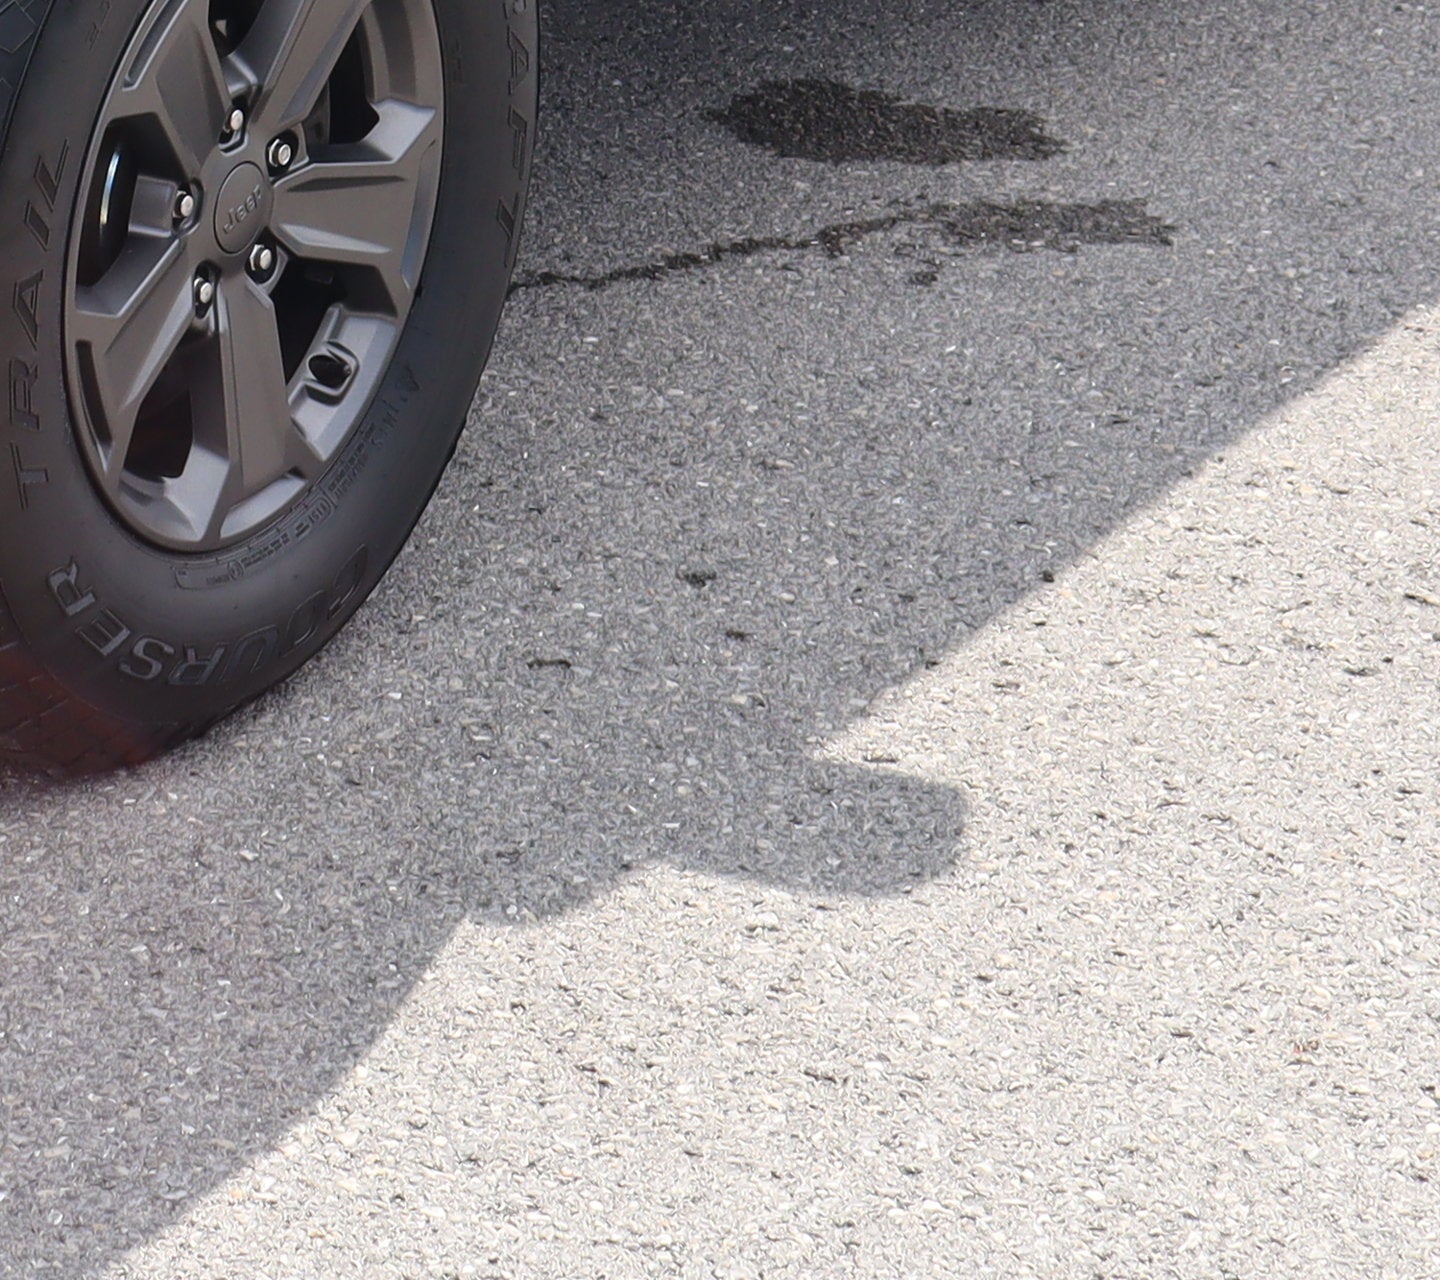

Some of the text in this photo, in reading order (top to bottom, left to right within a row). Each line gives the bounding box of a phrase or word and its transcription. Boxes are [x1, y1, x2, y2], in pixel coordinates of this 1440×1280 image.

[223, 184, 263, 234] Jeep
[9, 139, 70, 511] TRAIL
[46, 543, 367, 686] COURSER
